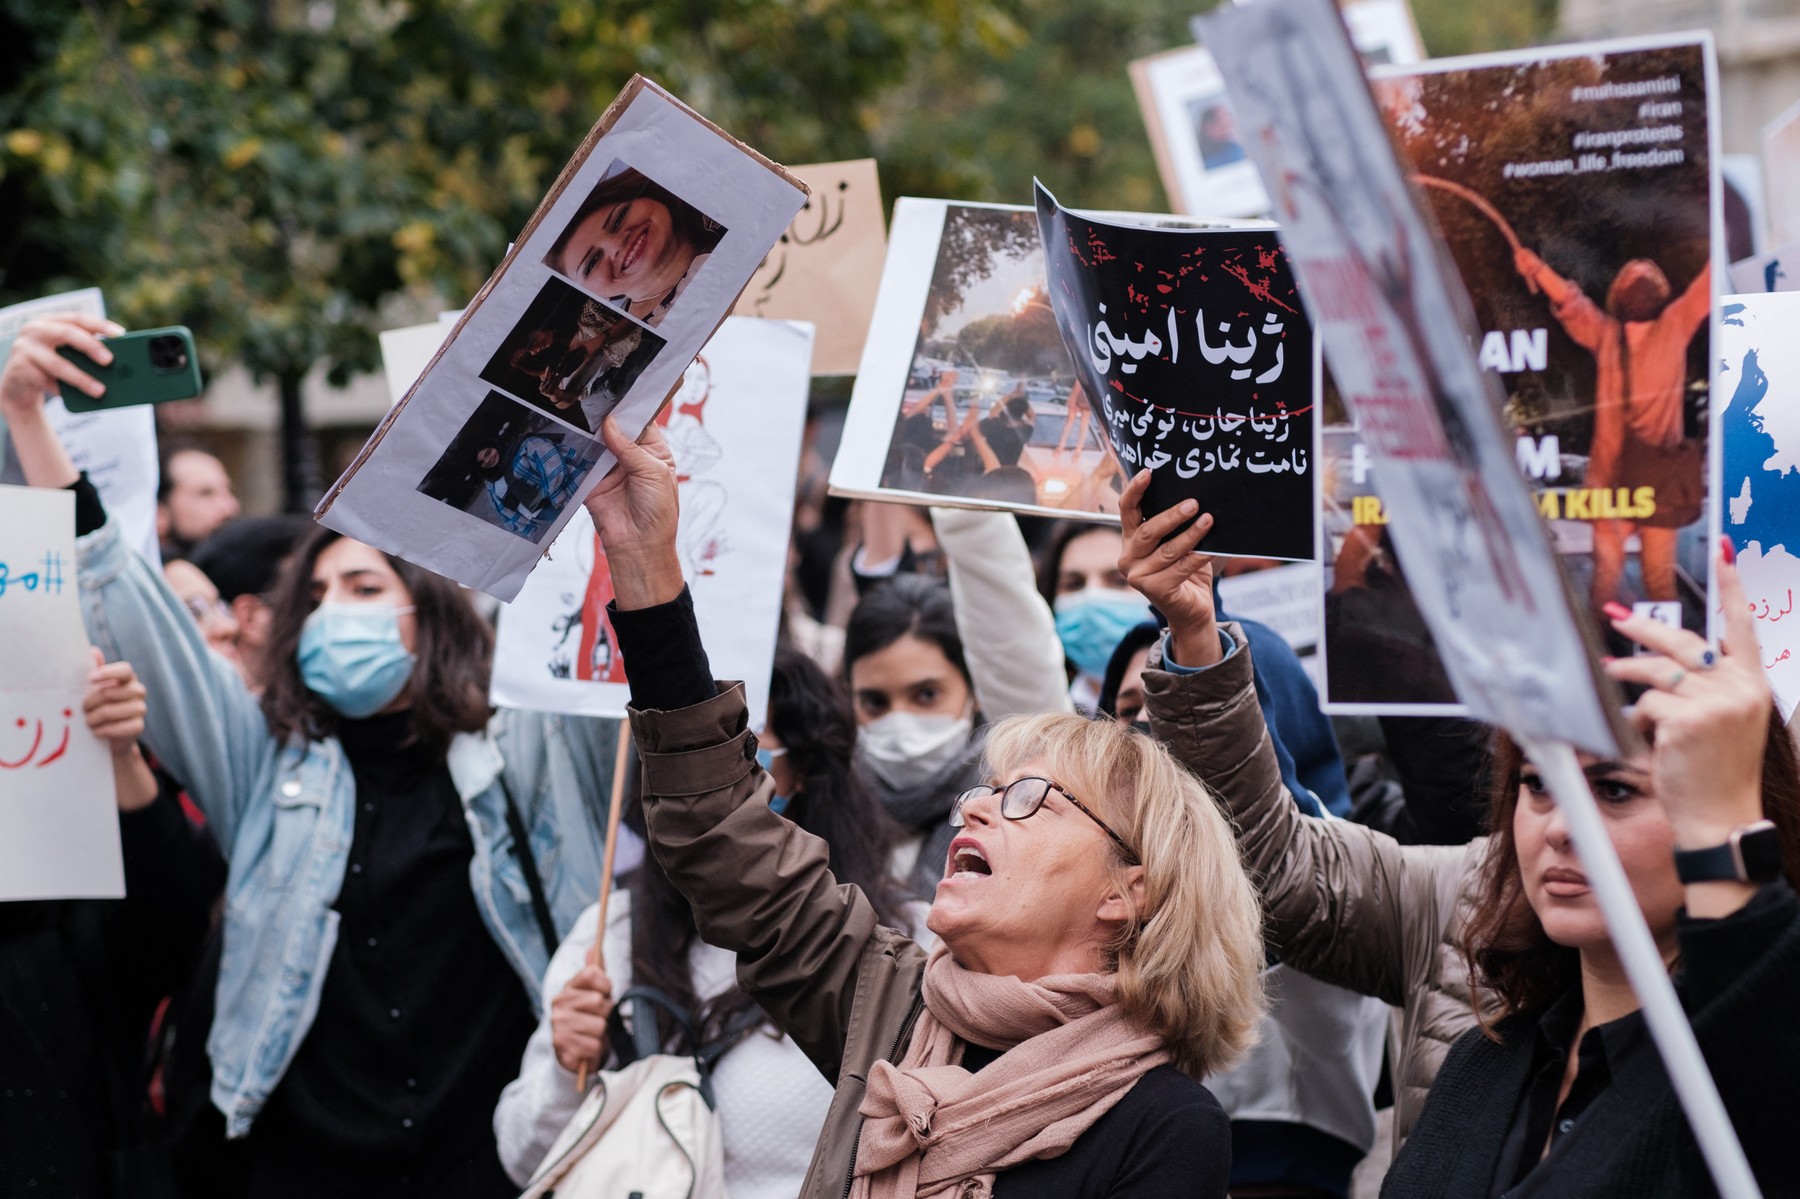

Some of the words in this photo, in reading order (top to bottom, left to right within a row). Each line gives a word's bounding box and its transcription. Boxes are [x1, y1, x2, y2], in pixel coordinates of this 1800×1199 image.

[1638, 101, 1683, 119] #iran
[1573, 124, 1684, 149] #iranprotests
[1503, 149, 1685, 179] #woman_life_freedom
[1087, 302, 1179, 375] امینی
[1195, 308, 1285, 384] ژینا
[1155, 408, 1176, 440] تو
[1120, 441, 1172, 470] خواهد
[1175, 443, 1241, 479] نمادی
[1246, 447, 1308, 475] نامت
[1565, 486, 1657, 520] KILLS
